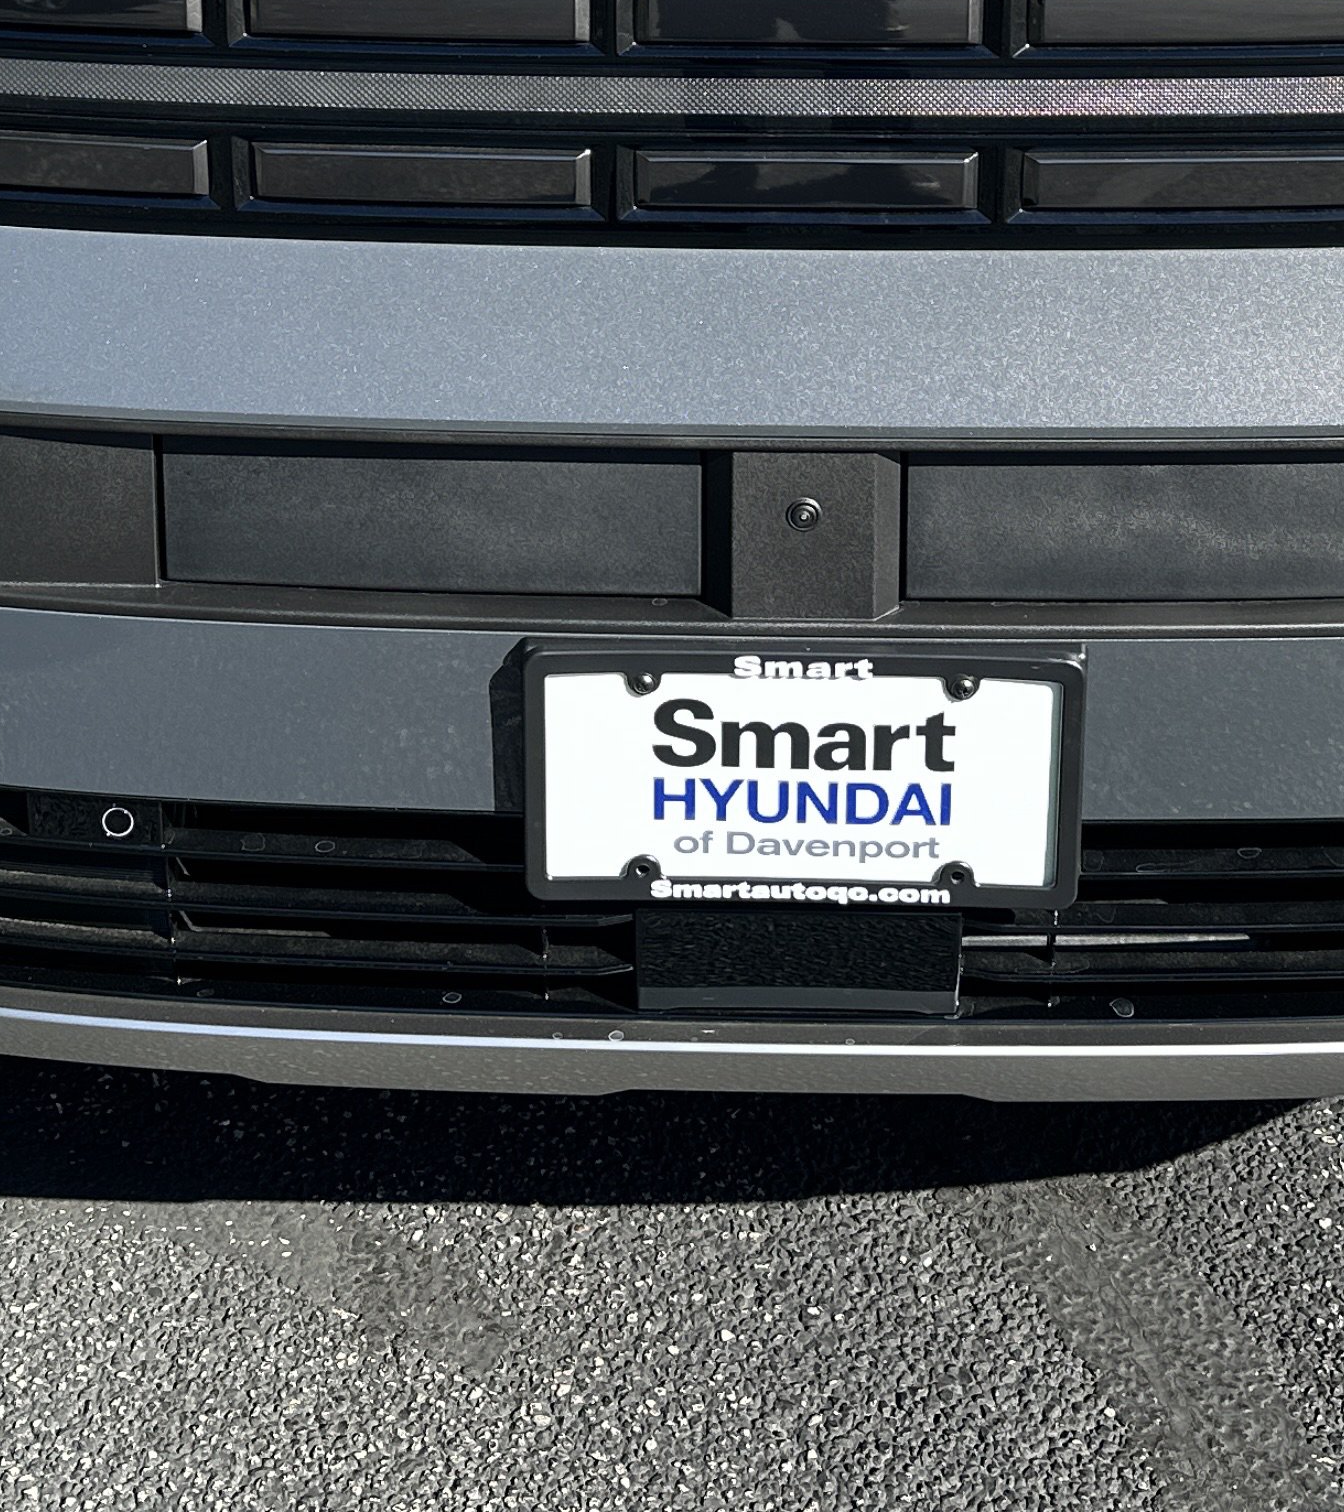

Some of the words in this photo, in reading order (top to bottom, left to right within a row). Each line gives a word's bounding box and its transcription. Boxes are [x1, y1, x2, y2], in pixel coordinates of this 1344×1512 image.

[733, 655, 874, 680] Smart
[652, 698, 957, 772] Smart
[653, 776, 952, 826] HYUNDAI
[673, 831, 714, 854] of
[726, 831, 941, 864] Davenport
